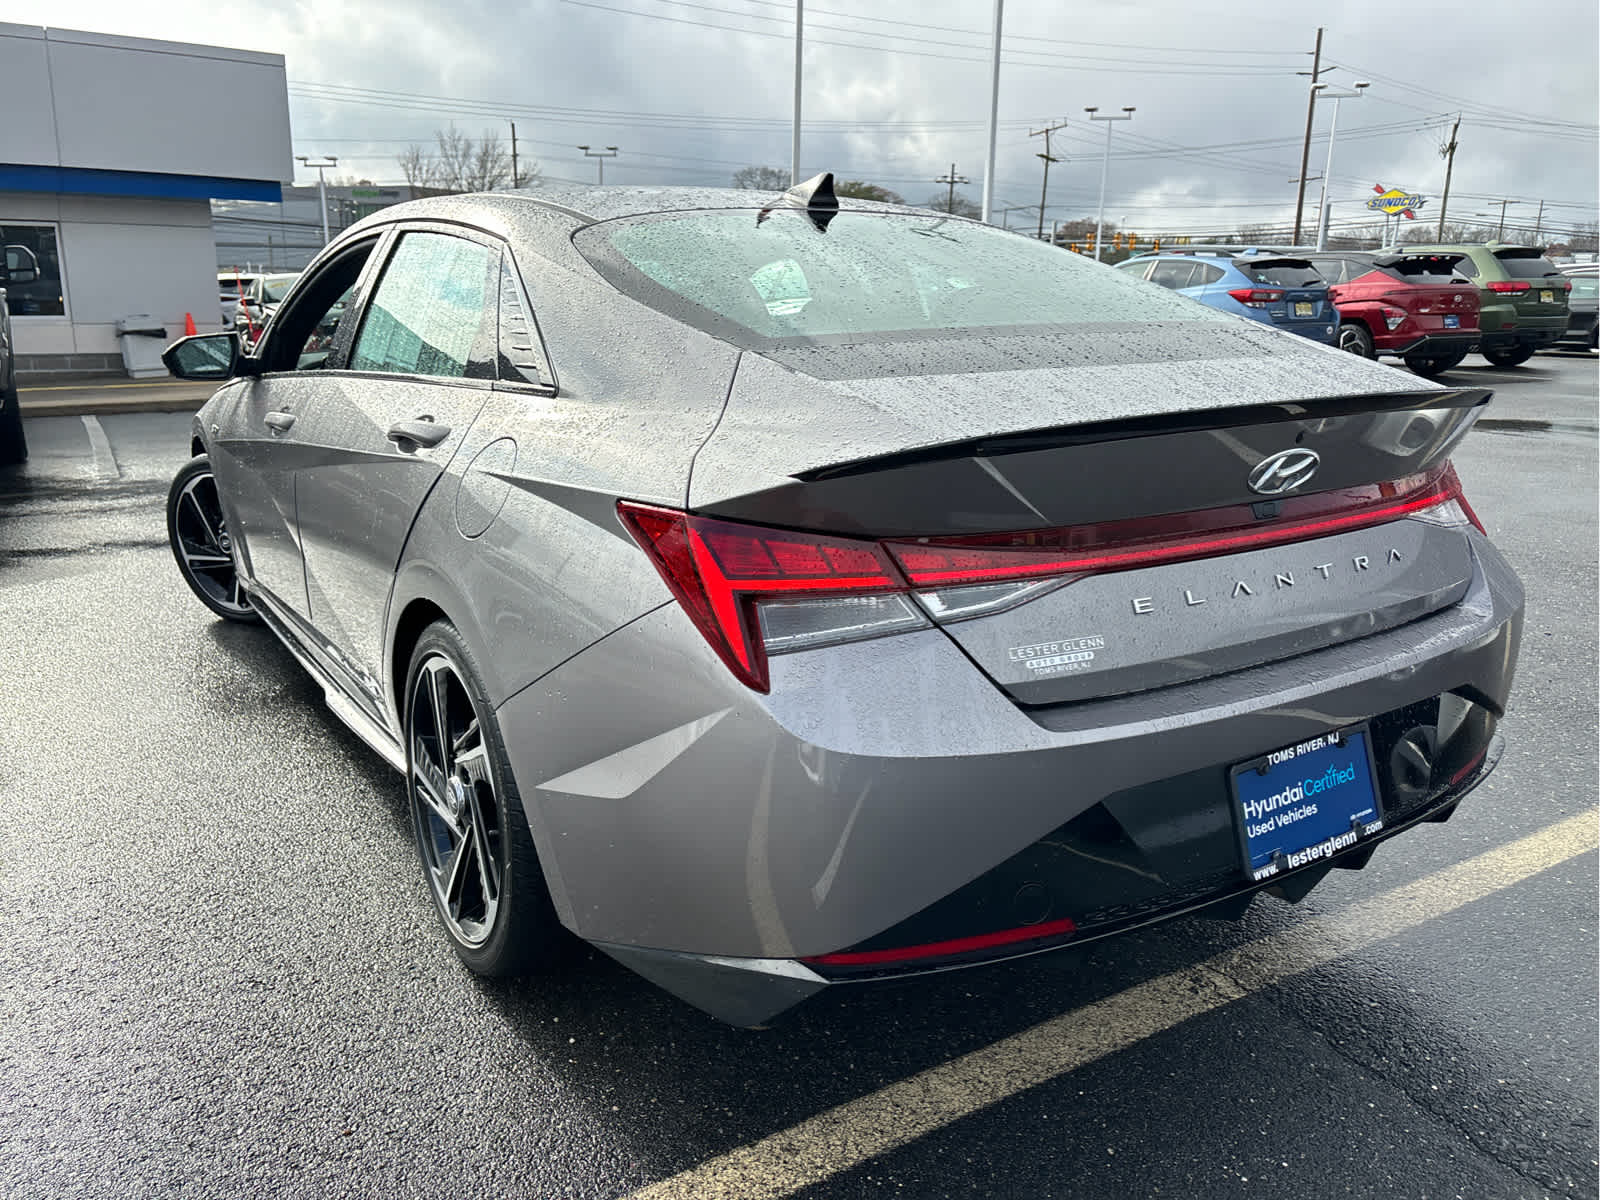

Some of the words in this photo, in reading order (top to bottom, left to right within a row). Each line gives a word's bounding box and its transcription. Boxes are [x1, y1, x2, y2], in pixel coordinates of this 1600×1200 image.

[1370, 196, 1416, 208] SUNOCO
[1132, 548, 1402, 614] ELANTRA
[1008, 644, 1060, 660] LESTER
[1062, 637, 1105, 651] GLENN
[1267, 748, 1295, 766] TOMS
[1297, 737, 1327, 757] RIVER,
[1328, 732, 1340, 746] NJ
[1243, 782, 1304, 819] Hyundai
[1303, 763, 1355, 797] Certified
[1247, 819, 1276, 838] Used
[1275, 803, 1318, 827] Vehicles
[1253, 864, 1279, 881] www.
[1287, 831, 1357, 869] lesterglenn
[1364, 821, 1383, 836] .com
